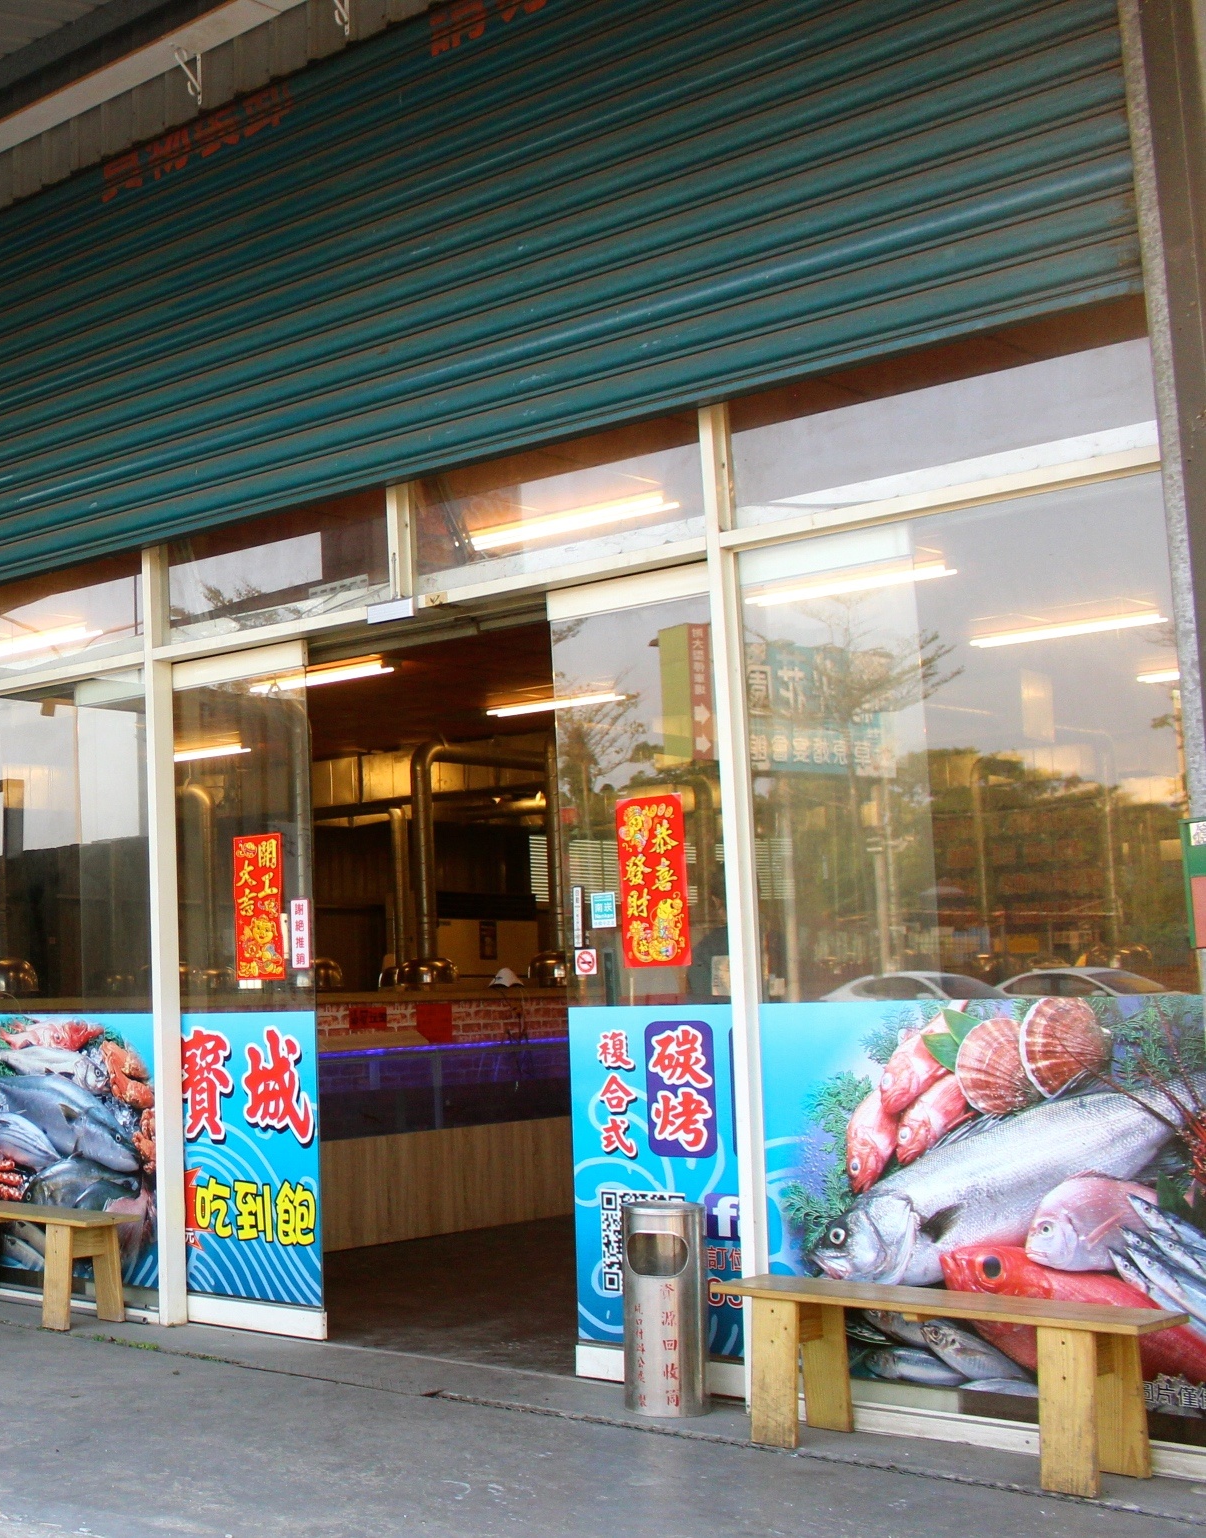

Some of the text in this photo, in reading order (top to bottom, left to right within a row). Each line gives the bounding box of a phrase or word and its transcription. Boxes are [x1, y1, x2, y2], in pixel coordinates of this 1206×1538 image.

[236, 860, 258, 917] 大吉
[258, 838, 279, 898] 開工
[623, 855, 652, 918] 發財
[649, 819, 679, 892] 恭喜
[182, 1026, 315, 1143] 寶城
[598, 1031, 636, 1157] 複合式
[651, 1026, 712, 1150] 碳烤
[196, 1177, 316, 1246] 吃到飽
